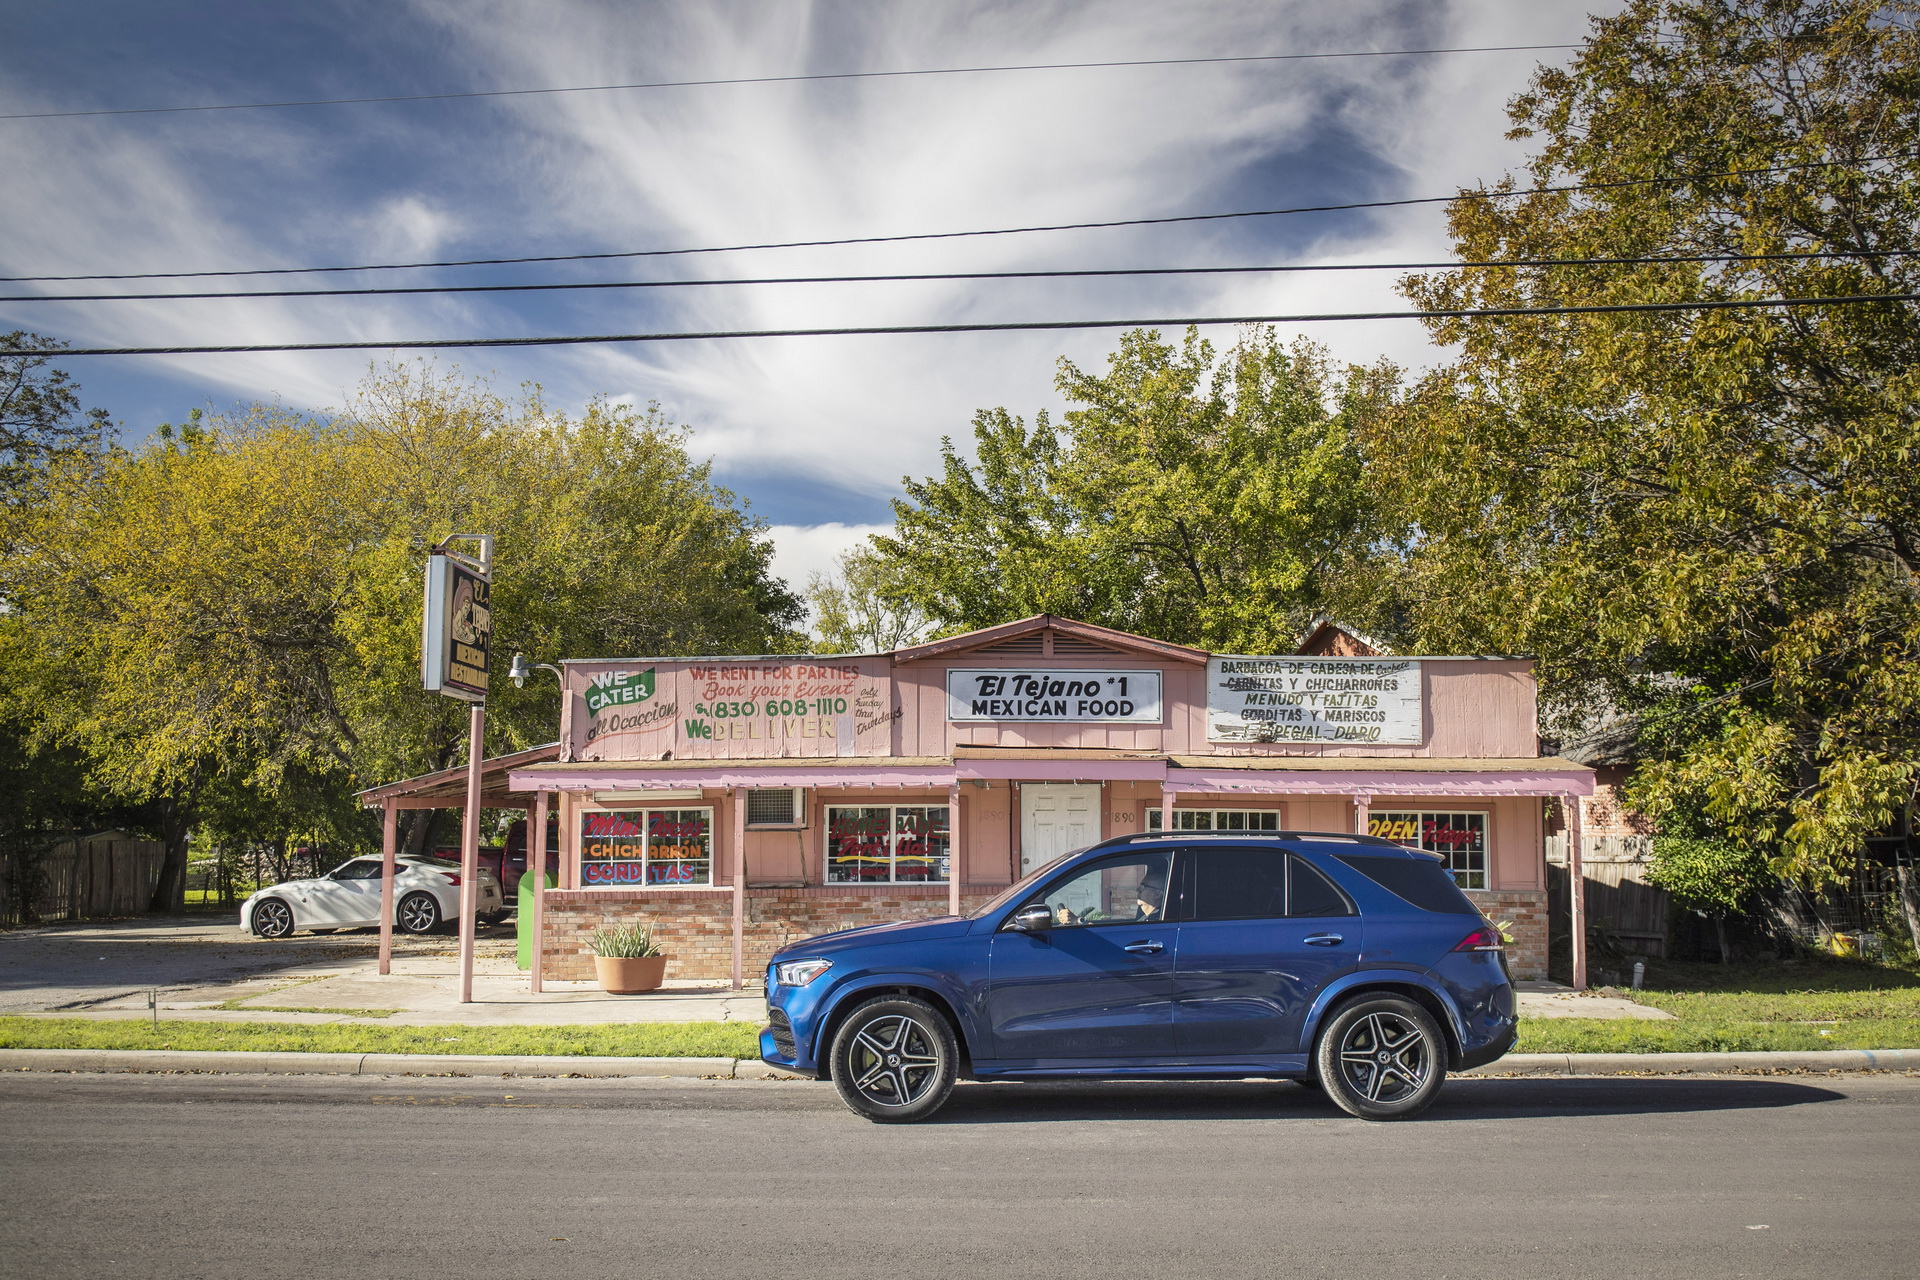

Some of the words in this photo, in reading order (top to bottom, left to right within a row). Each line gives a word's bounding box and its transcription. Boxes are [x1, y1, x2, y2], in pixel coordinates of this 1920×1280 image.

[473, 579, 489, 604] El
[688, 666, 717, 680] WE
[720, 666, 758, 680] RENT
[762, 666, 792, 680] FOR
[797, 666, 860, 680] PARTIES
[1221, 661, 1282, 674] BARBACOA
[1288, 662, 1304, 674] DE
[1310, 662, 1356, 674] CABESA
[1360, 664, 1374, 674] DE
[591, 670, 628, 689] WE
[974, 675, 1007, 697] El
[1012, 675, 1100, 700] Tejano
[1228, 677, 1283, 690] CARNITAS
[1289, 678, 1298, 690] Y
[1306, 678, 1398, 691] CHICHARRONES
[589, 684, 648, 709] CATER
[702, 681, 746, 701] Book
[749, 684, 792, 702] your
[794, 681, 854, 699] Event
[1245, 694, 1304, 706] MENUDO
[1309, 694, 1318, 706] Y
[1323, 694, 1378, 706] FAJITAS
[710, 702, 760, 718] (830)
[766, 698, 847, 717] 608-1110
[855, 698, 884, 710] Sunday
[855, 709, 874, 718] thru
[972, 700, 1067, 716] MEXICAN
[1078, 700, 1134, 716] FOOD
[1240, 708, 1302, 722] GORDITAS
[1310, 710, 1319, 722] Y
[1324, 710, 1386, 722] MARISCOS
[684, 718, 712, 740] We
[713, 718, 836, 741] DELIVER
[1368, 819, 1418, 840] OPEN
[837, 837, 934, 856] Tortillas
[584, 864, 694, 883] GORDITAS
